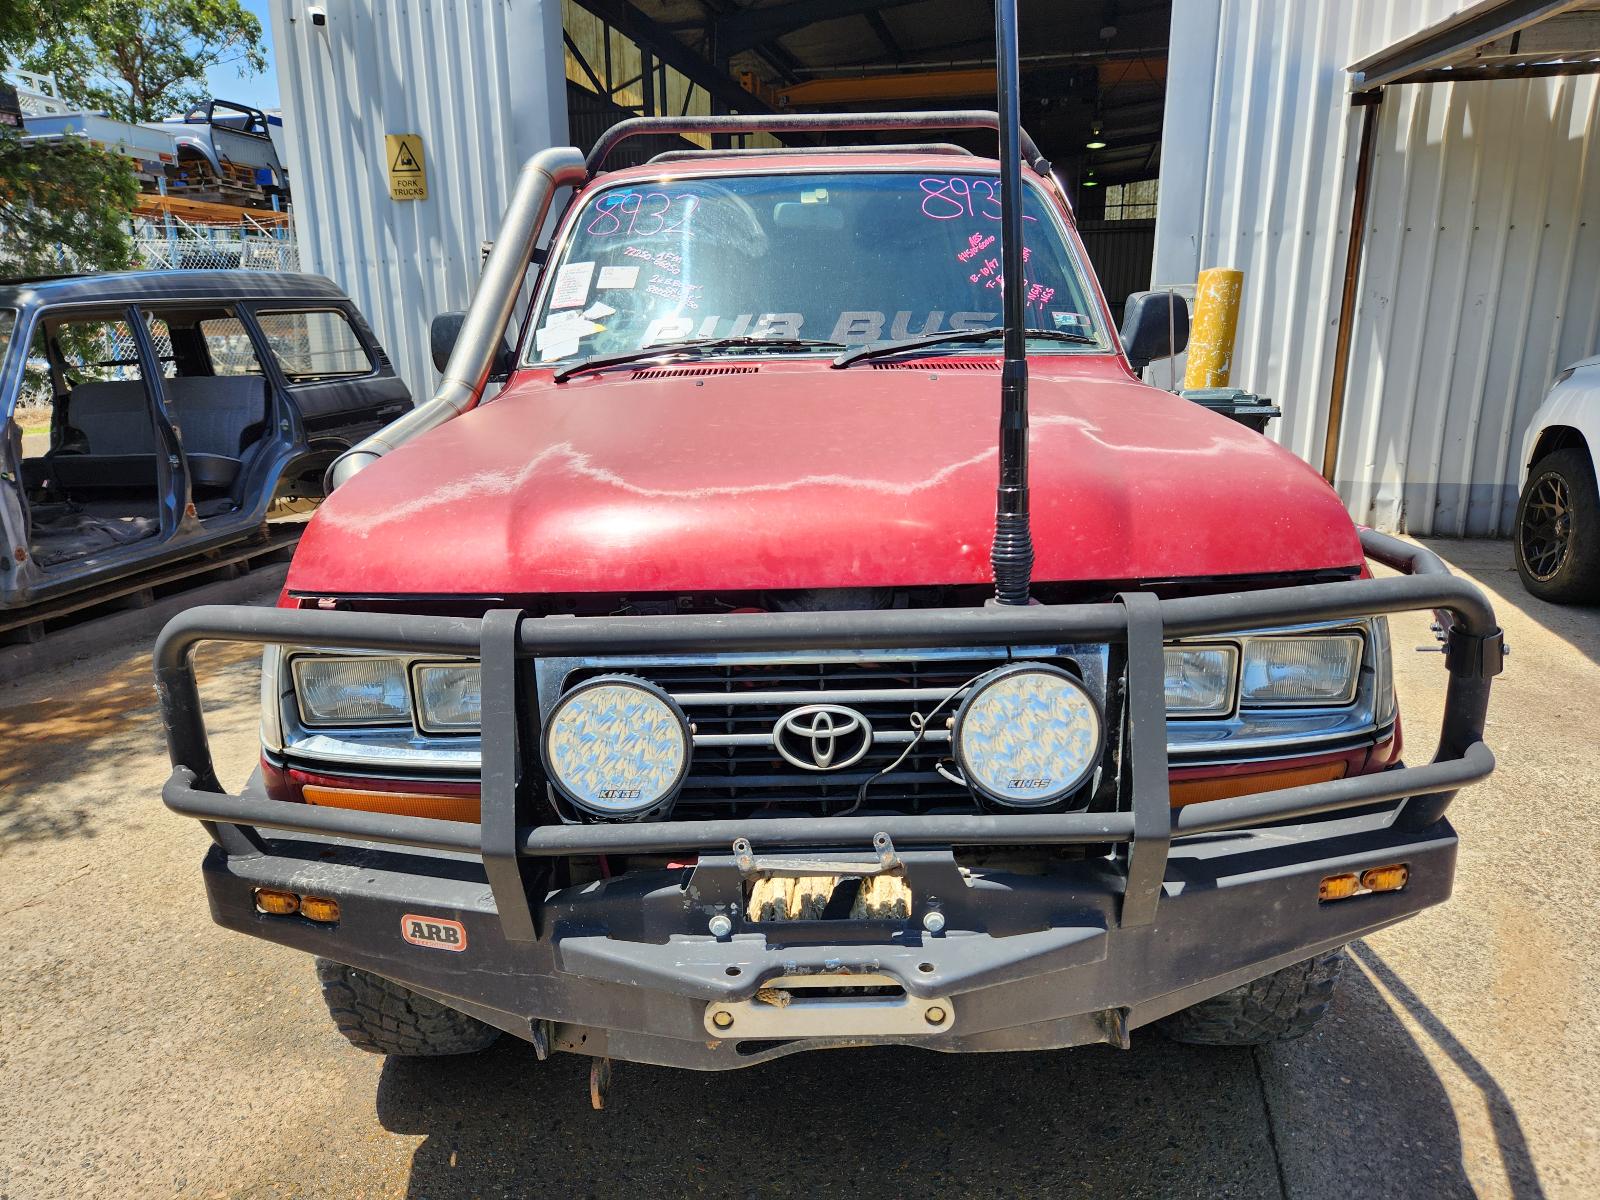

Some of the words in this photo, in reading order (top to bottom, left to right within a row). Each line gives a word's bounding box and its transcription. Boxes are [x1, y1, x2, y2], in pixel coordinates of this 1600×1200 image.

[397, 180, 419, 188] FORK
[393, 188, 424, 197] TRUCKS
[587, 192, 700, 236] 8932
[640, 313, 804, 349] PUB
[1007, 778, 1052, 789] KINGS
[597, 789, 641, 799] KINGS
[410, 921, 460, 945] ARB
